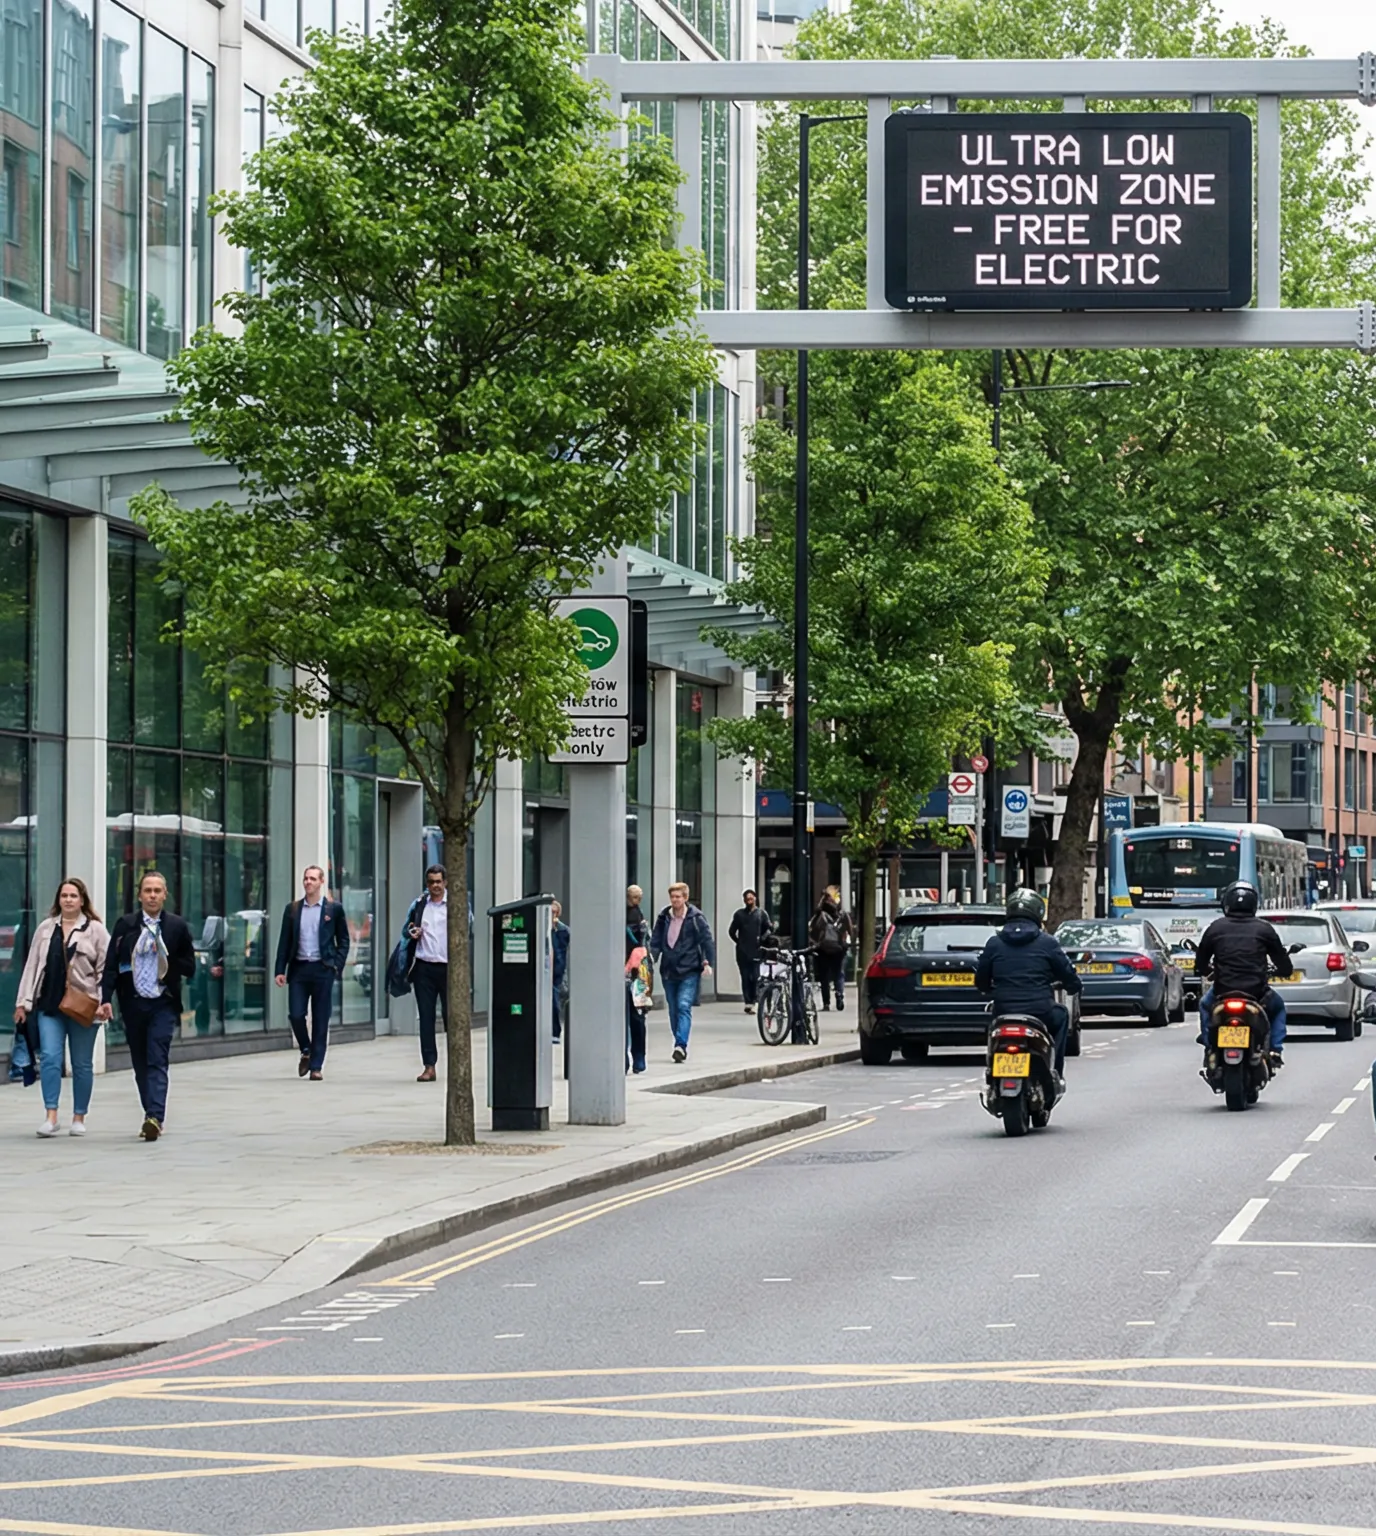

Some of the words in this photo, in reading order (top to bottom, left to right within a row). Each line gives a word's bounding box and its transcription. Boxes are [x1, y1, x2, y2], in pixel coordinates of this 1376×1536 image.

[961, 135, 1081, 165] ULTRA
[1103, 134, 1174, 165] LOW
[921, 174, 1098, 205] EMISSION
[1120, 174, 1215, 205] ZONE
[995, 214, 1090, 245] FREE
[1112, 214, 1181, 245] FOR
[976, 254, 1160, 285] ELECTRIC
[571, 741, 604, 757] only
